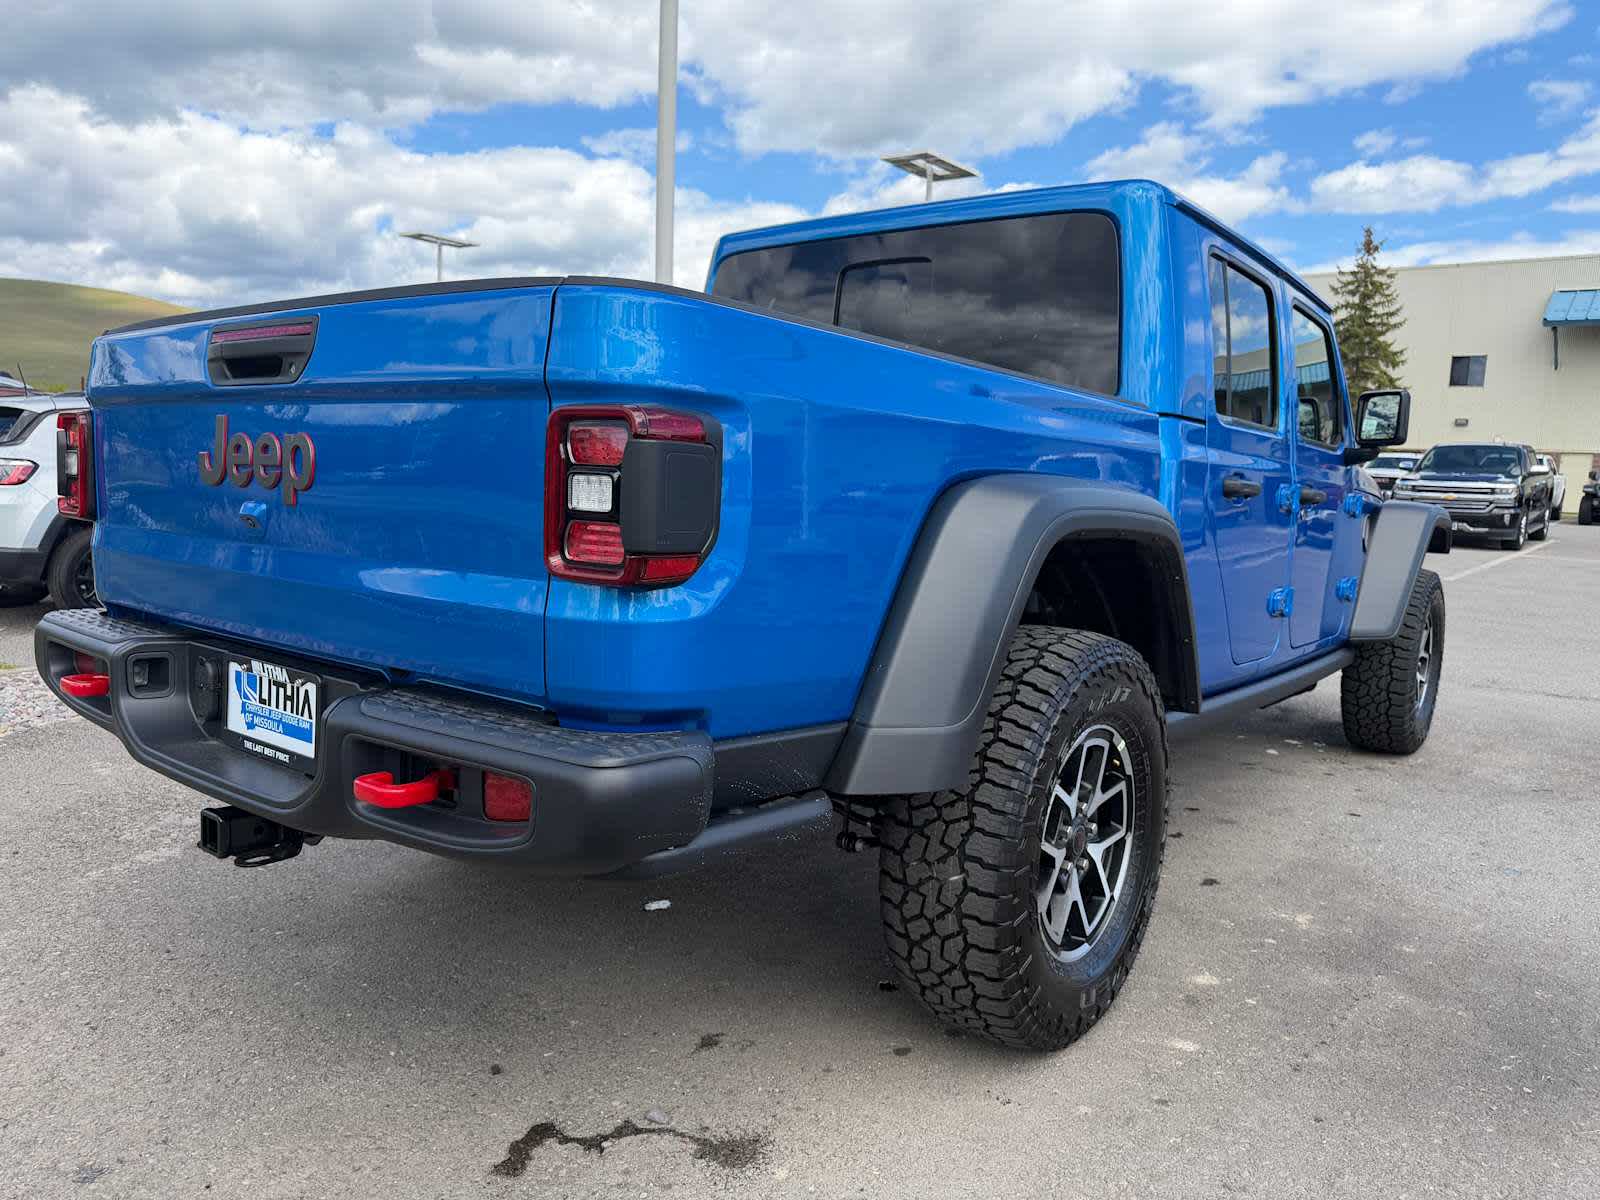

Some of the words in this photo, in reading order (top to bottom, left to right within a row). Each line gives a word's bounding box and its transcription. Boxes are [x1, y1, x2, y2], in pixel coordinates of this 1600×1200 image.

[198, 414, 316, 506] Jeep
[259, 661, 290, 683] LITHIA
[259, 676, 313, 720] LITHIA
[245, 702, 270, 717] CHRYSLER
[270, 710, 282, 720] JEEP
[282, 713, 298, 726] DODGE
[298, 718, 310, 730] RAM
[245, 712, 254, 723] OF
[253, 715, 284, 734] MISSOULA
[244, 740, 253, 750] THE
[252, 743, 264, 753] LAST
[264, 747, 276, 758] BEST
[275, 751, 290, 763] PRICE
